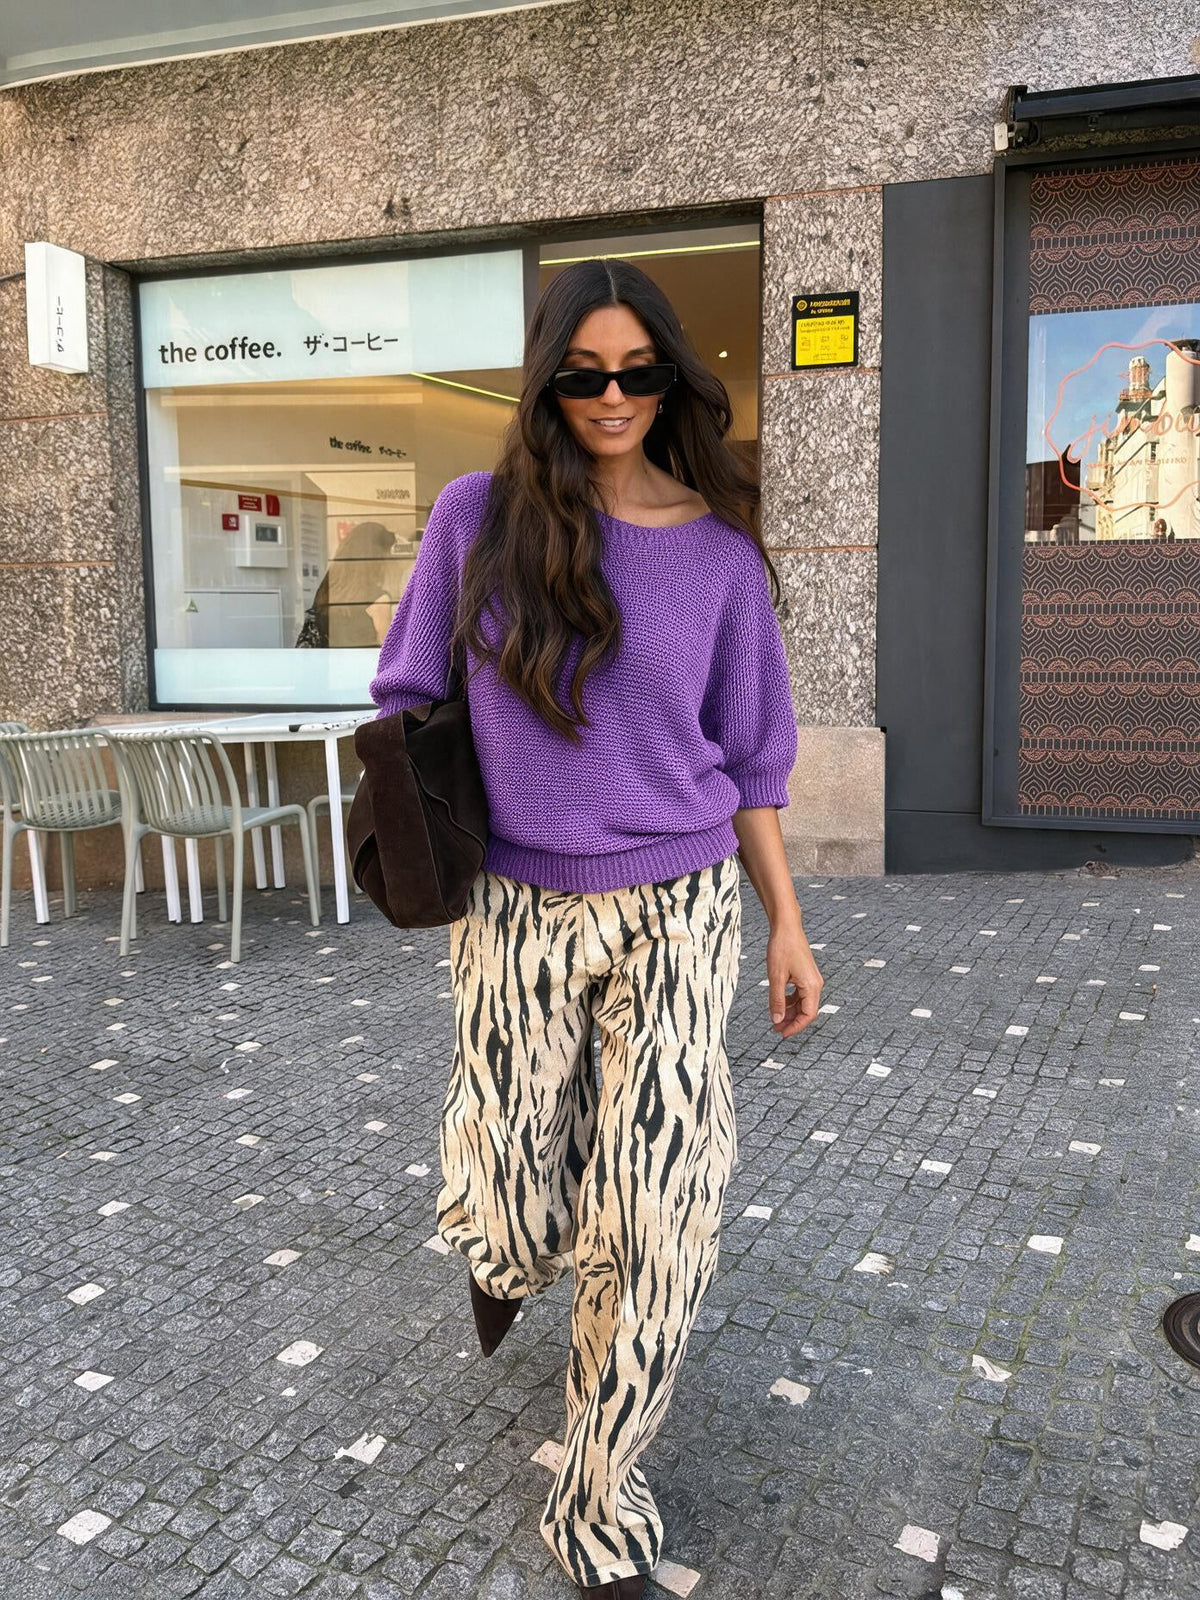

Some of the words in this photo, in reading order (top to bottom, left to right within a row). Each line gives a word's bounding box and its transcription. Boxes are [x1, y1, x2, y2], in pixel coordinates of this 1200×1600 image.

[158, 341, 198, 364] the
[204, 336, 283, 361] coffee.
[303, 332, 399, 356] ザ・コーヒー
